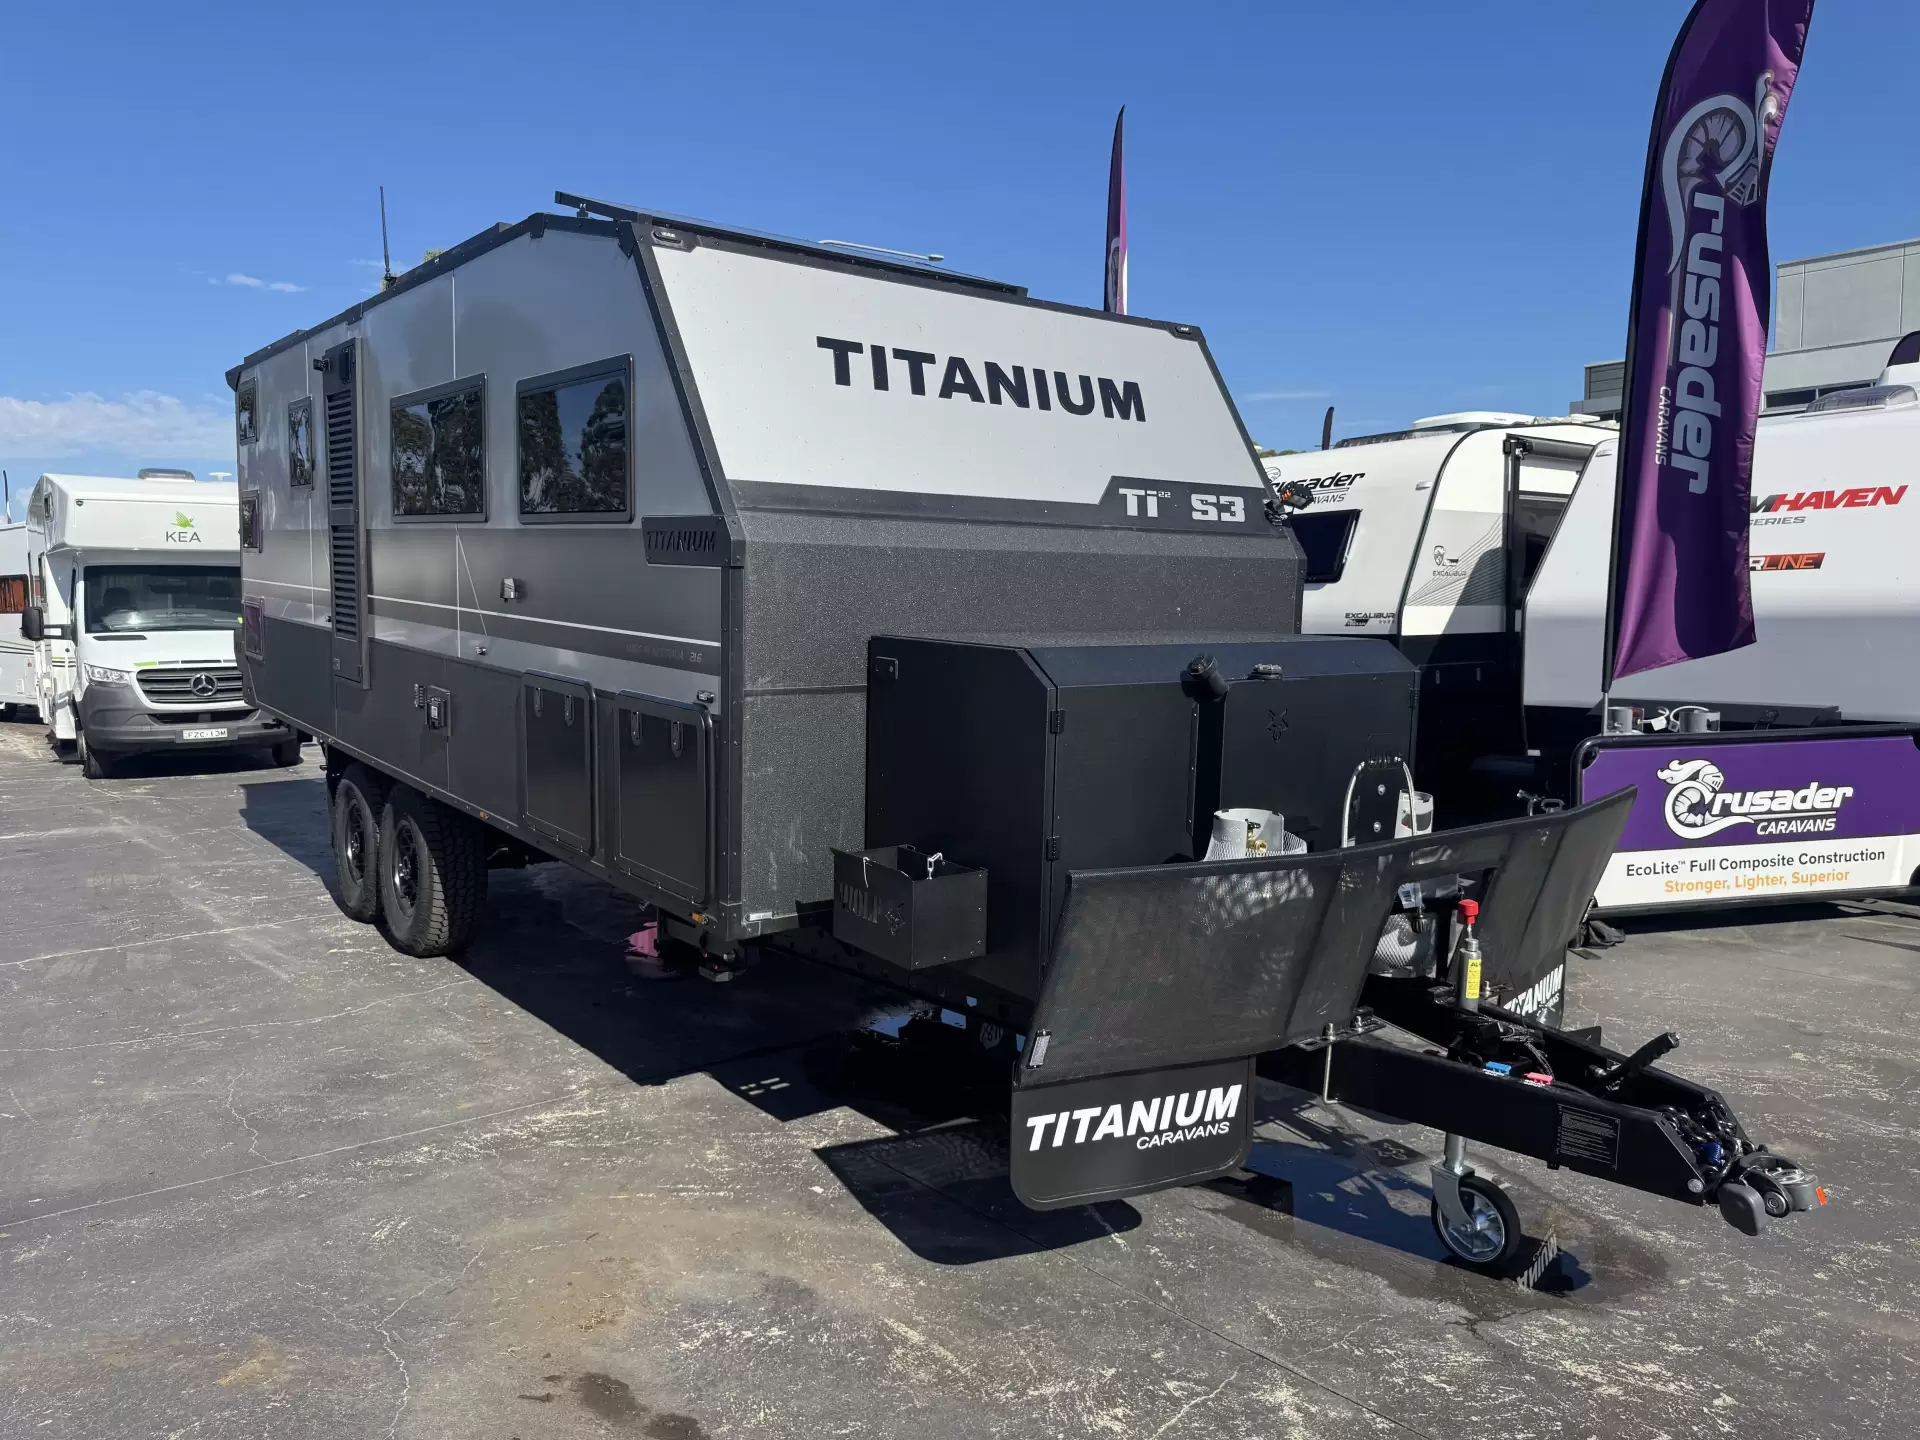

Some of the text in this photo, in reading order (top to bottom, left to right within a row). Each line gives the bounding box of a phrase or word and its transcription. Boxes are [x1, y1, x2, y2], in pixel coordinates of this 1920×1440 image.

[816, 336, 1146, 422] TITANIUM
[1655, 385, 1672, 466] CARAVANS
[1191, 493, 1246, 523] S3
[1312, 493, 1346, 505] AVANS
[1749, 485, 1909, 513] MHAVEN
[1749, 516, 1807, 527] ERIES
[165, 530, 202, 544] KEA
[646, 530, 717, 552] TITANIUM
[1749, 554, 1820, 571] RLINE
[1664, 780, 1854, 839] Crusader
[1756, 817, 1837, 836] CARAVANS
[1689, 858, 1716, 873] Full
[1719, 853, 1794, 874] Composite
[1798, 848, 1886, 866] Construction
[1664, 870, 1850, 895] Stronger, Lighter, Superior
[1026, 1084, 1243, 1152] TITANIUM
[1136, 1121, 1230, 1150] CARAVANS
